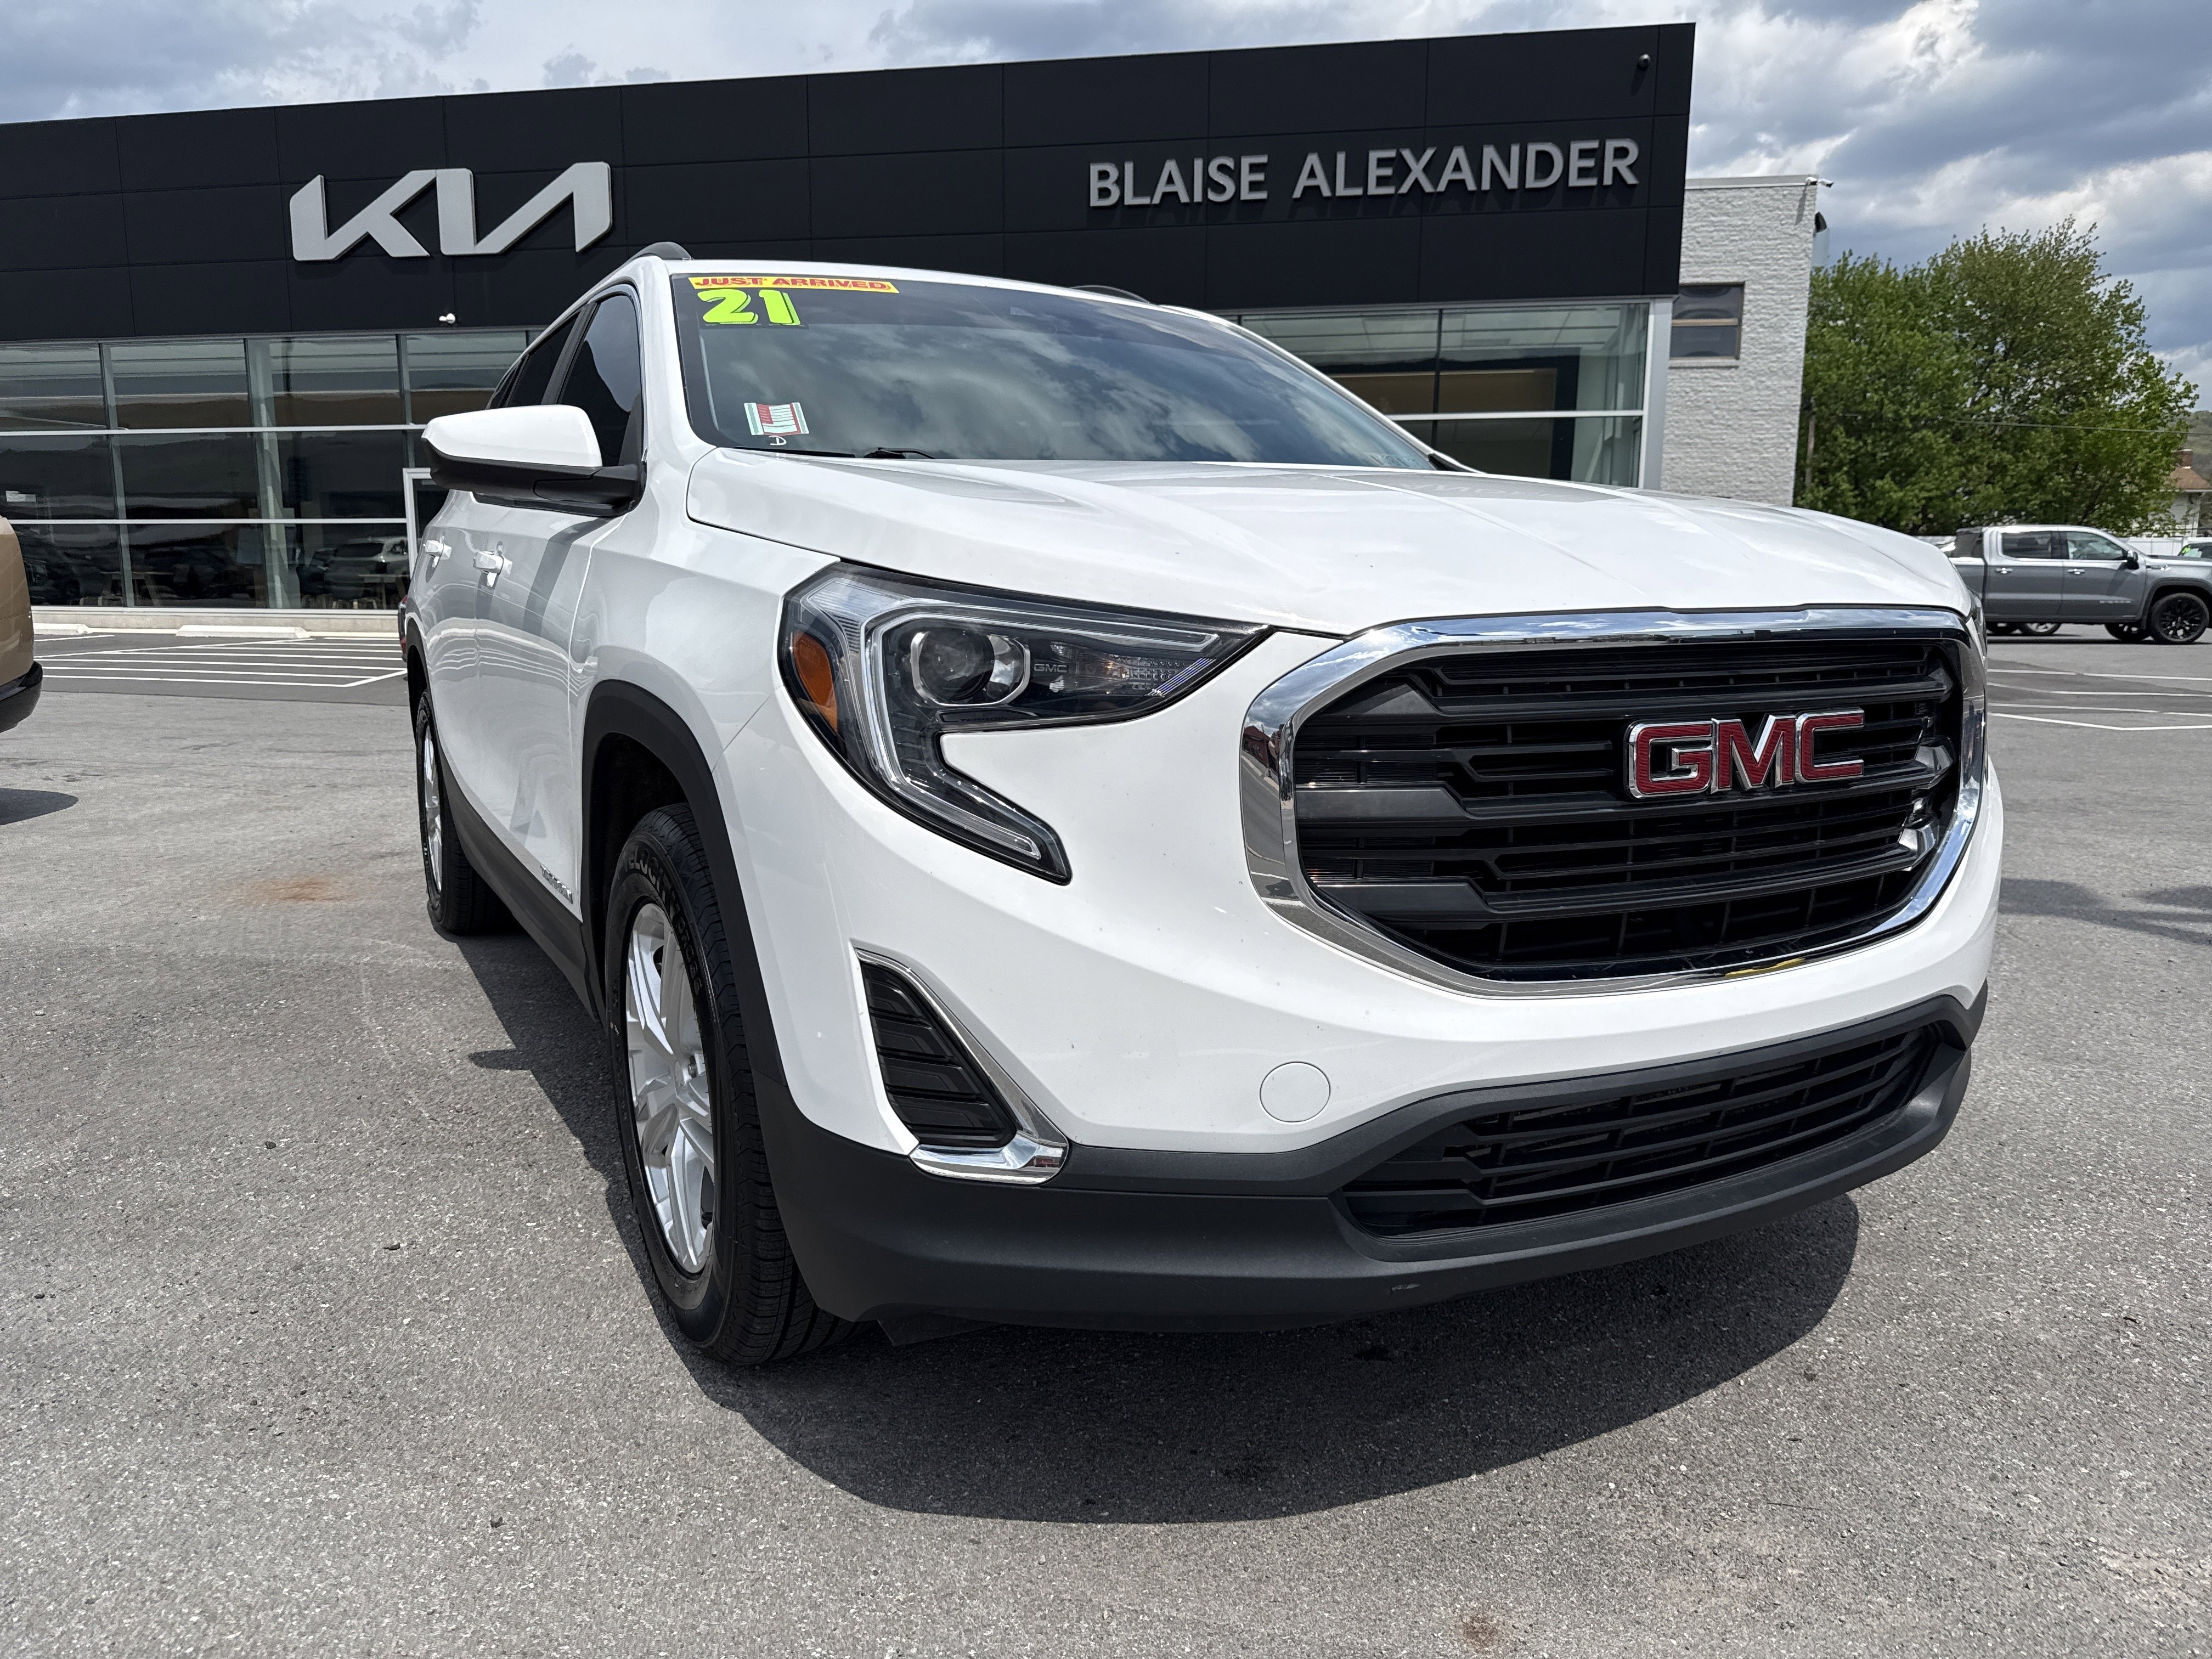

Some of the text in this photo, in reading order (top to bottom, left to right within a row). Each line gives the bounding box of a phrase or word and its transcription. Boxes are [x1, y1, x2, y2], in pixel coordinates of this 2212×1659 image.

[1090, 138, 1640, 207] BLAISE ALEXANDER
[289, 161, 612, 261] KIA
[695, 278, 891, 290] JUST ARRIVED
[697, 289, 800, 325] 21
[1034, 663, 1067, 673] GMC
[1627, 707, 1864, 799] GMC
